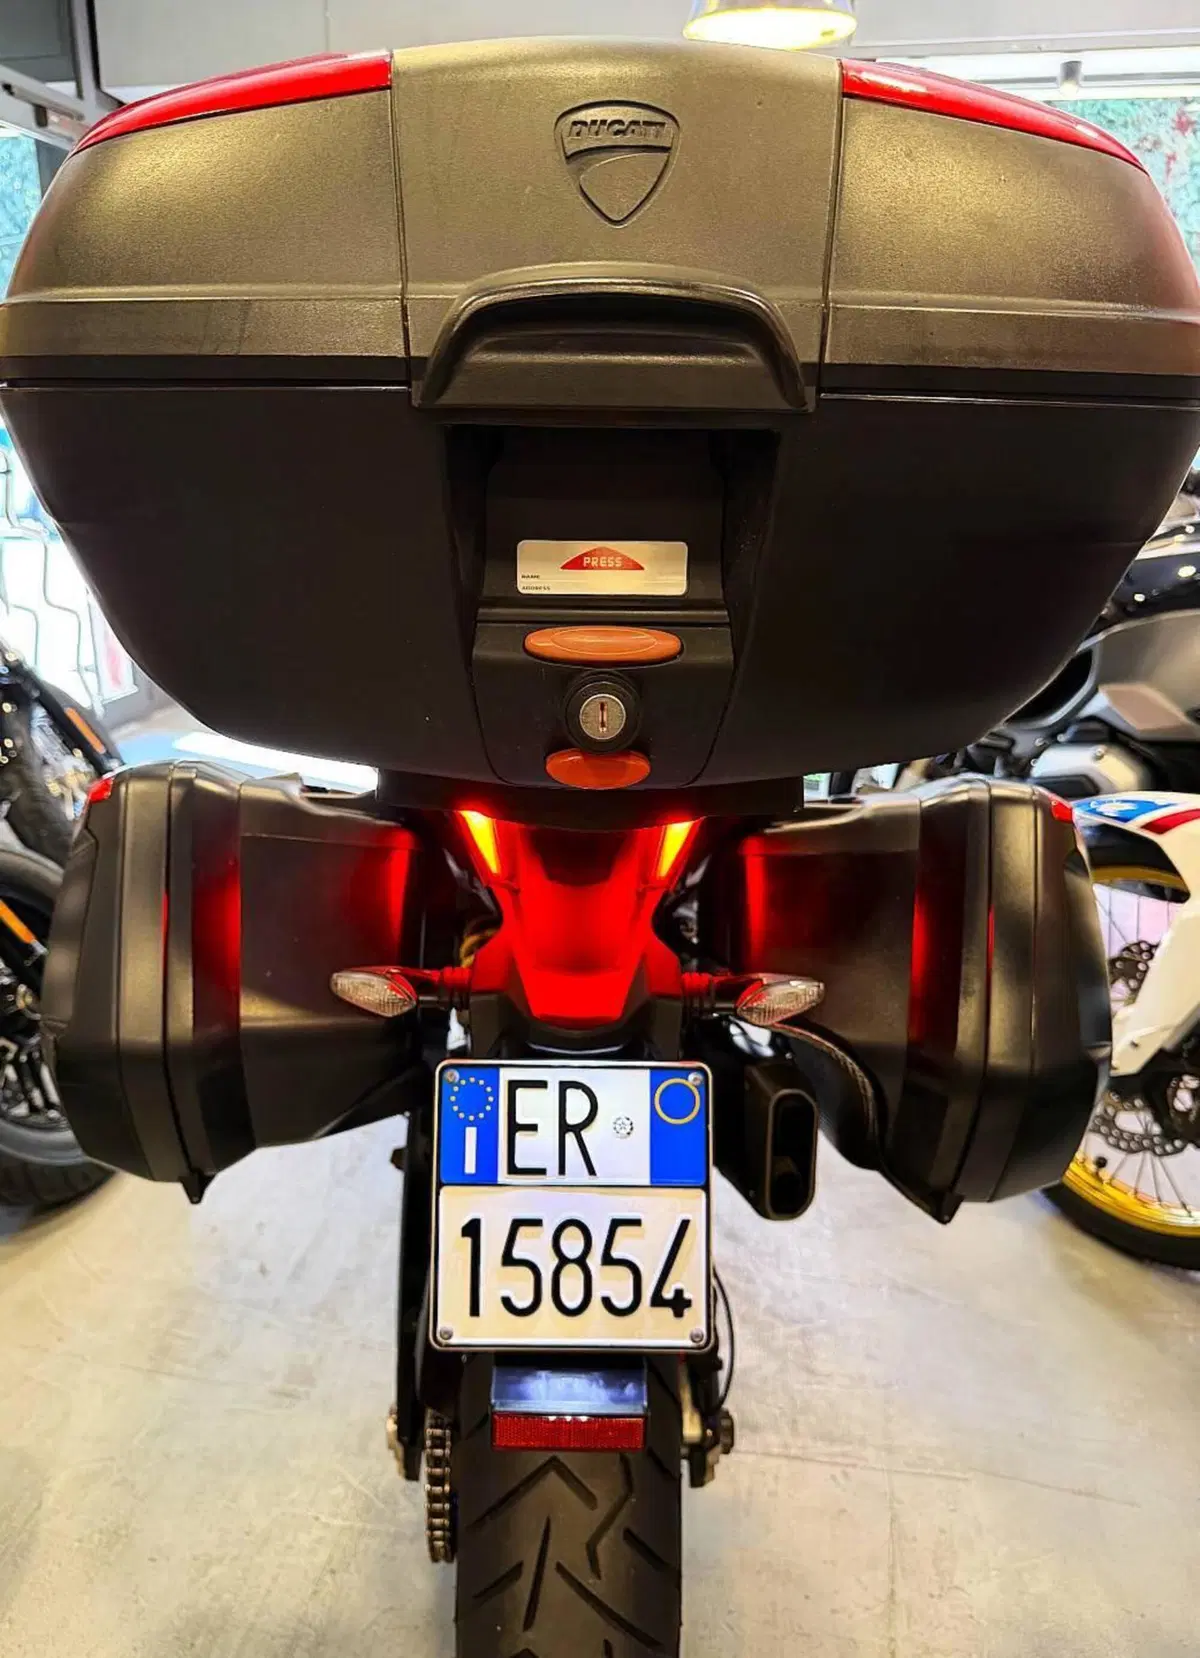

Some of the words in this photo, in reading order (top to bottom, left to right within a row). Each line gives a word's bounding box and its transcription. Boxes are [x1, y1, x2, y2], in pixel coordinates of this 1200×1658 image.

[568, 118, 667, 138] DUCATI
[582, 556, 623, 568] PRESS
[506, 1079, 599, 1177] ER
[460, 1217, 693, 1319] 15854
